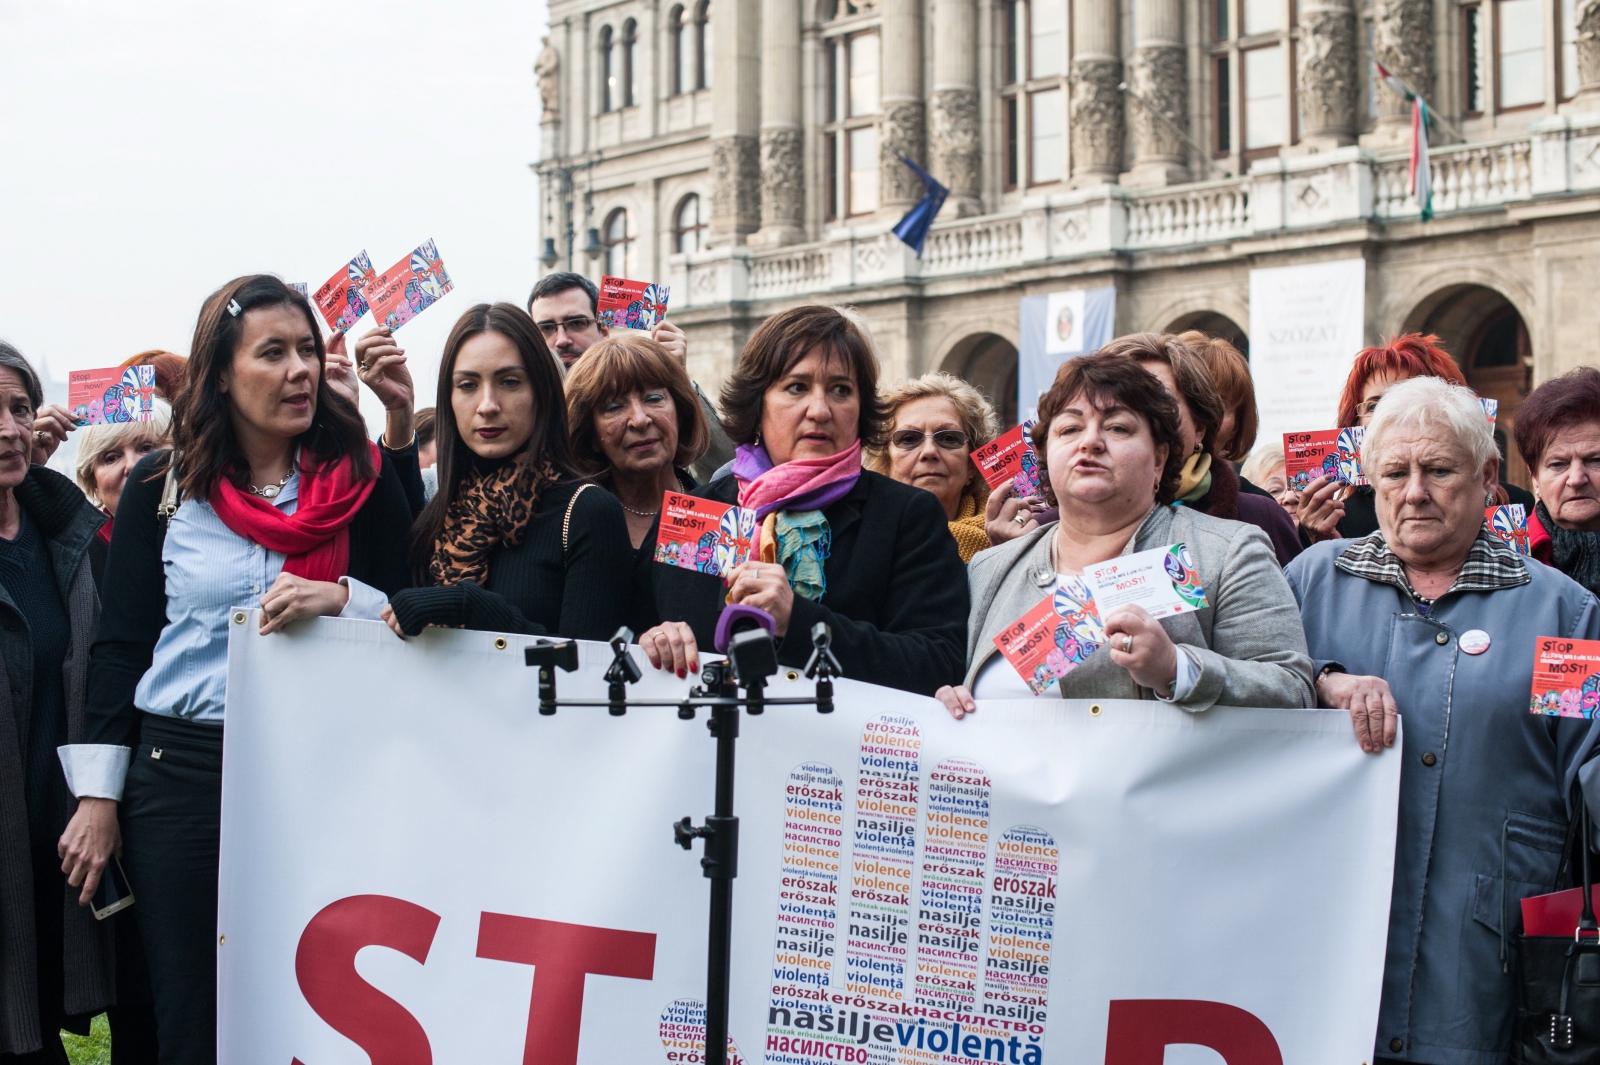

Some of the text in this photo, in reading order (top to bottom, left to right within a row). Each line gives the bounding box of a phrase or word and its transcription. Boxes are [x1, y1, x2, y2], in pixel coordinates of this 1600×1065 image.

[367, 276, 388, 294] STOP
[605, 278, 624, 286] STOP
[316, 284, 330, 300] STOP
[378, 280, 404, 304] MOST!
[608, 292, 632, 300] MOST!
[1288, 435, 1311, 443] STOP
[977, 444, 998, 461] STOP
[1296, 448, 1324, 458] MOST!
[992, 451, 1019, 473] MOST!
[669, 496, 695, 509] STOP
[673, 517, 705, 531] MOST!
[1094, 566, 1118, 579] STOP
[1116, 575, 1146, 591] MOST!
[1000, 622, 1026, 646] STOP
[1019, 626, 1052, 656] MOST!
[1542, 641, 1573, 653] STOP
[1549, 663, 1588, 674] MOST!
[880, 715, 914, 726] nasilje
[866, 722, 920, 737] erőszak
[863, 731, 921, 749] violence
[861, 745, 918, 758] насилство
[860, 769, 919, 781] nasilje
[938, 764, 984, 774] насилство
[791, 773, 843, 787] nasilje nasilje
[860, 777, 918, 792] erőszak
[931, 772, 991, 787] erőszak
[787, 784, 843, 801] erőszak
[858, 788, 918, 803] erőszak
[857, 798, 916, 816] violence
[786, 807, 841, 824] violence
[927, 811, 988, 828] violence
[786, 822, 842, 836] насилство
[858, 819, 914, 836] nasilje
[927, 825, 988, 842] violence
[785, 833, 840, 847] насилство
[785, 841, 839, 858] violence
[925, 845, 986, 859] насилство
[998, 840, 1058, 857] violence
[784, 855, 838, 871] violence
[854, 860, 911, 878] violence
[923, 863, 985, 879] erőszak
[995, 857, 1057, 871] насилство
[782, 876, 837, 894] erőszak
[854, 875, 910, 893] violence
[922, 881, 982, 895] насилство
[993, 873, 1057, 899] erőszak
[781, 891, 836, 906] erőszak
[852, 889, 910, 906] erőszak
[992, 895, 1054, 914] nasilje
[778, 914, 834, 928] насилство
[851, 910, 908, 926] nasilje
[919, 909, 980, 928] nasilje
[779, 926, 834, 941] nasilje
[849, 924, 907, 946] nasilje
[919, 923, 980, 939] erőszak
[777, 939, 834, 957] nasilje
[848, 940, 906, 955] насилство
[919, 934, 979, 953] nasilje
[990, 934, 1050, 952] violence
[776, 952, 831, 970] violence
[918, 946, 978, 962] насилство
[989, 946, 1049, 964] violence
[918, 962, 976, 980] violence
[987, 957, 1049, 976] nasilje
[916, 975, 976, 991] erőszak
[986, 970, 1048, 985] насилство
[846, 982, 902, 1000] violence
[915, 988, 975, 1003] насилство
[1010, 985, 1046, 995] violence
[674, 1000, 704, 1009] nasilje
[915, 997, 973, 1012] nasilje
[985, 991, 1047, 1007] erőszak
[772, 984, 1044, 1035] erőszak erőszak насилство
[984, 1003, 1046, 1024] nasilje
[769, 1006, 894, 1044] nasilje
[961, 1024, 1010, 1038] violence
[767, 1035, 867, 1064] насилство
[899, 1046, 939, 1060] violence
